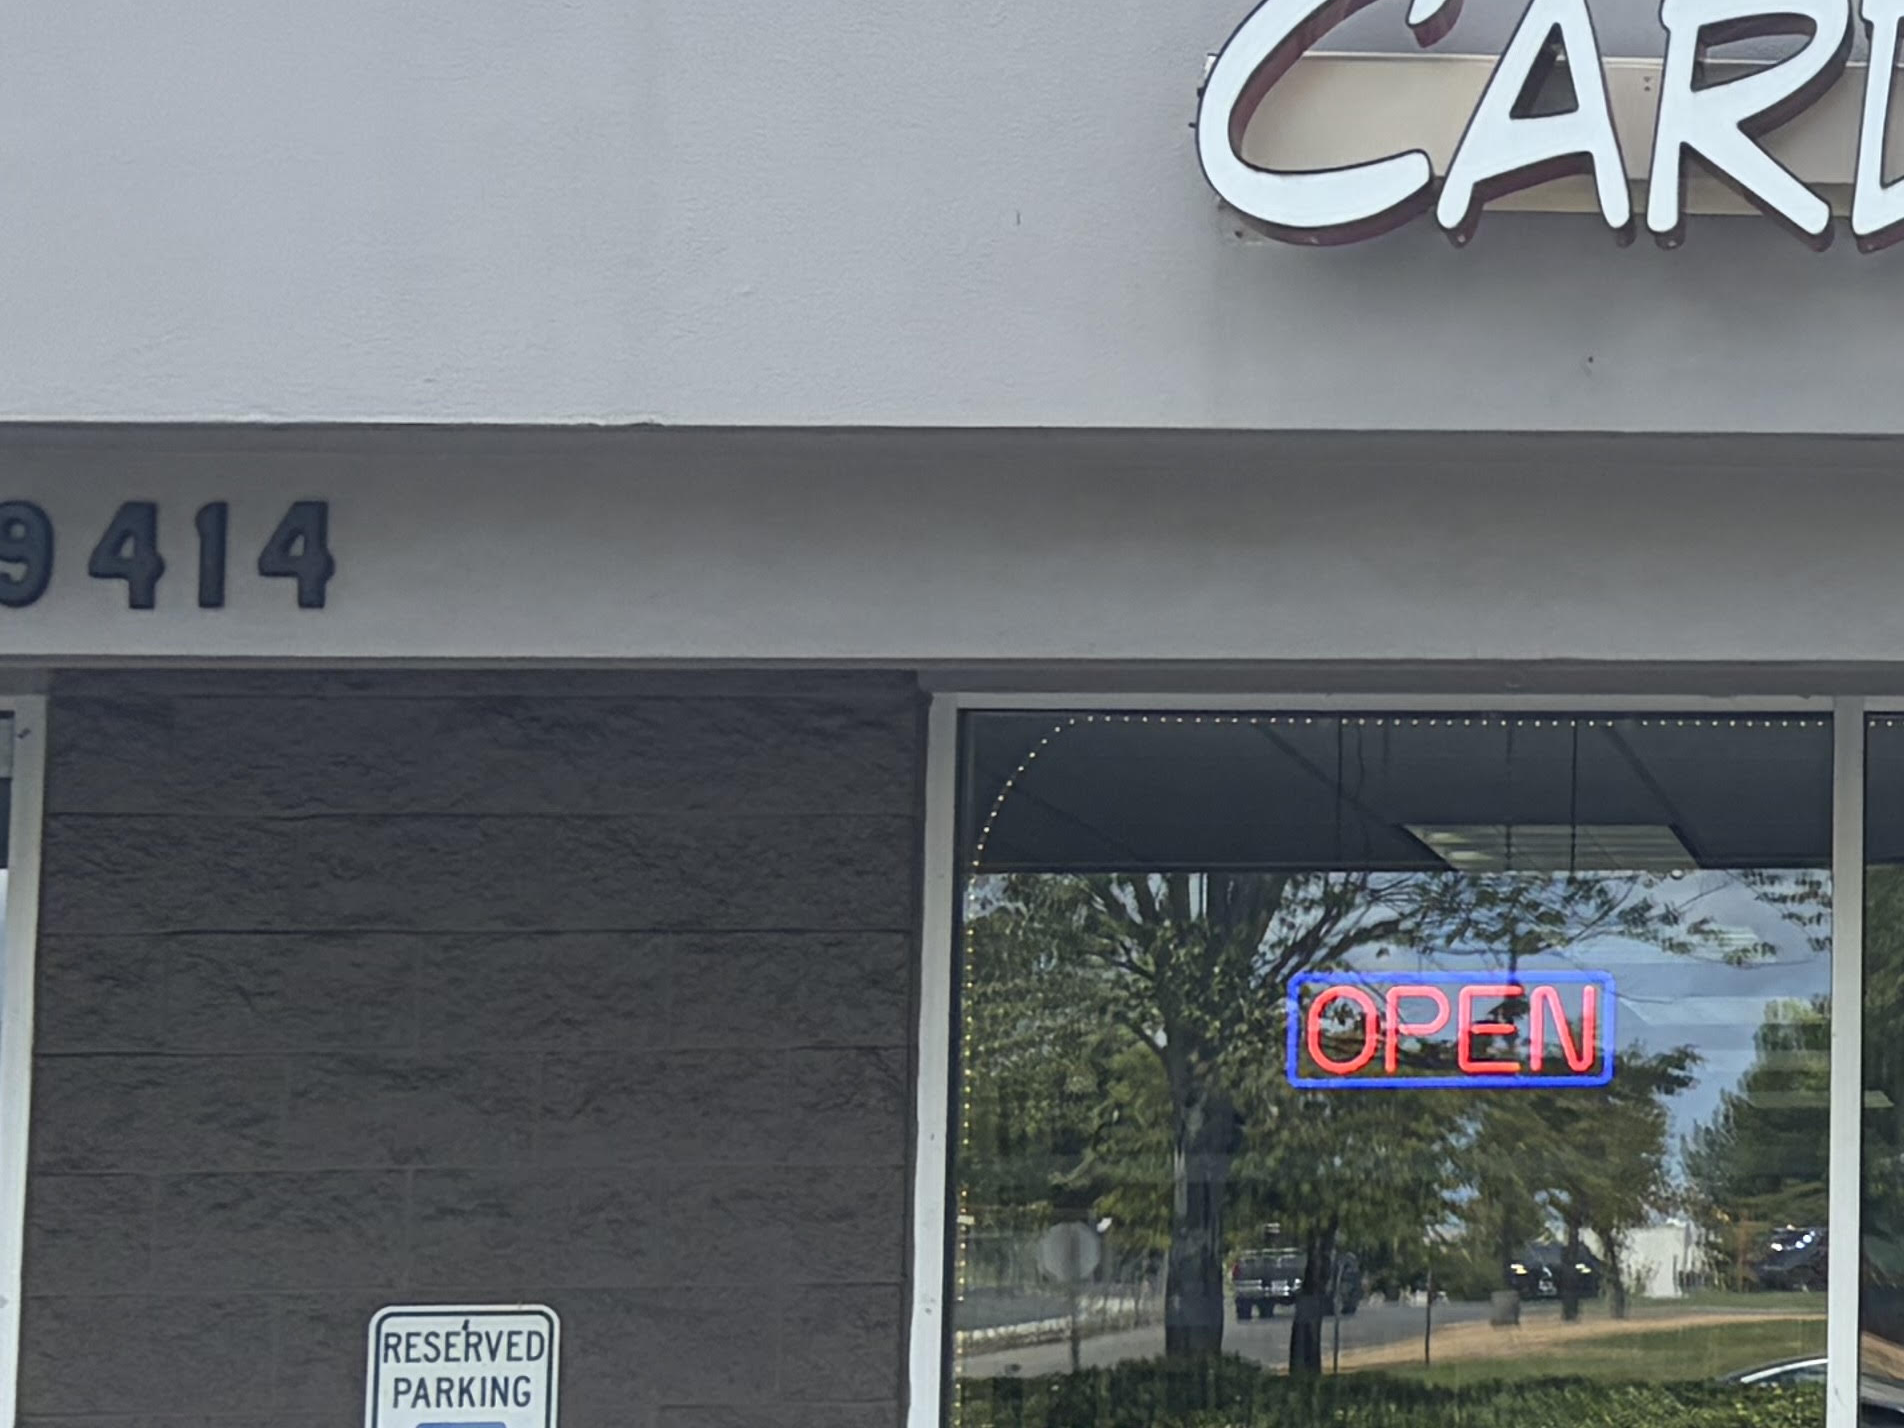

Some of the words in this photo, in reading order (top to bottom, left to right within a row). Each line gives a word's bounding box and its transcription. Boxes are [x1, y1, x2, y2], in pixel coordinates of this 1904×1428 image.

[0, 498, 336, 610] 9414
[1305, 983, 1597, 1076] OPEN
[383, 1330, 545, 1363] RESERVED
[392, 1375, 532, 1409] PARKING
